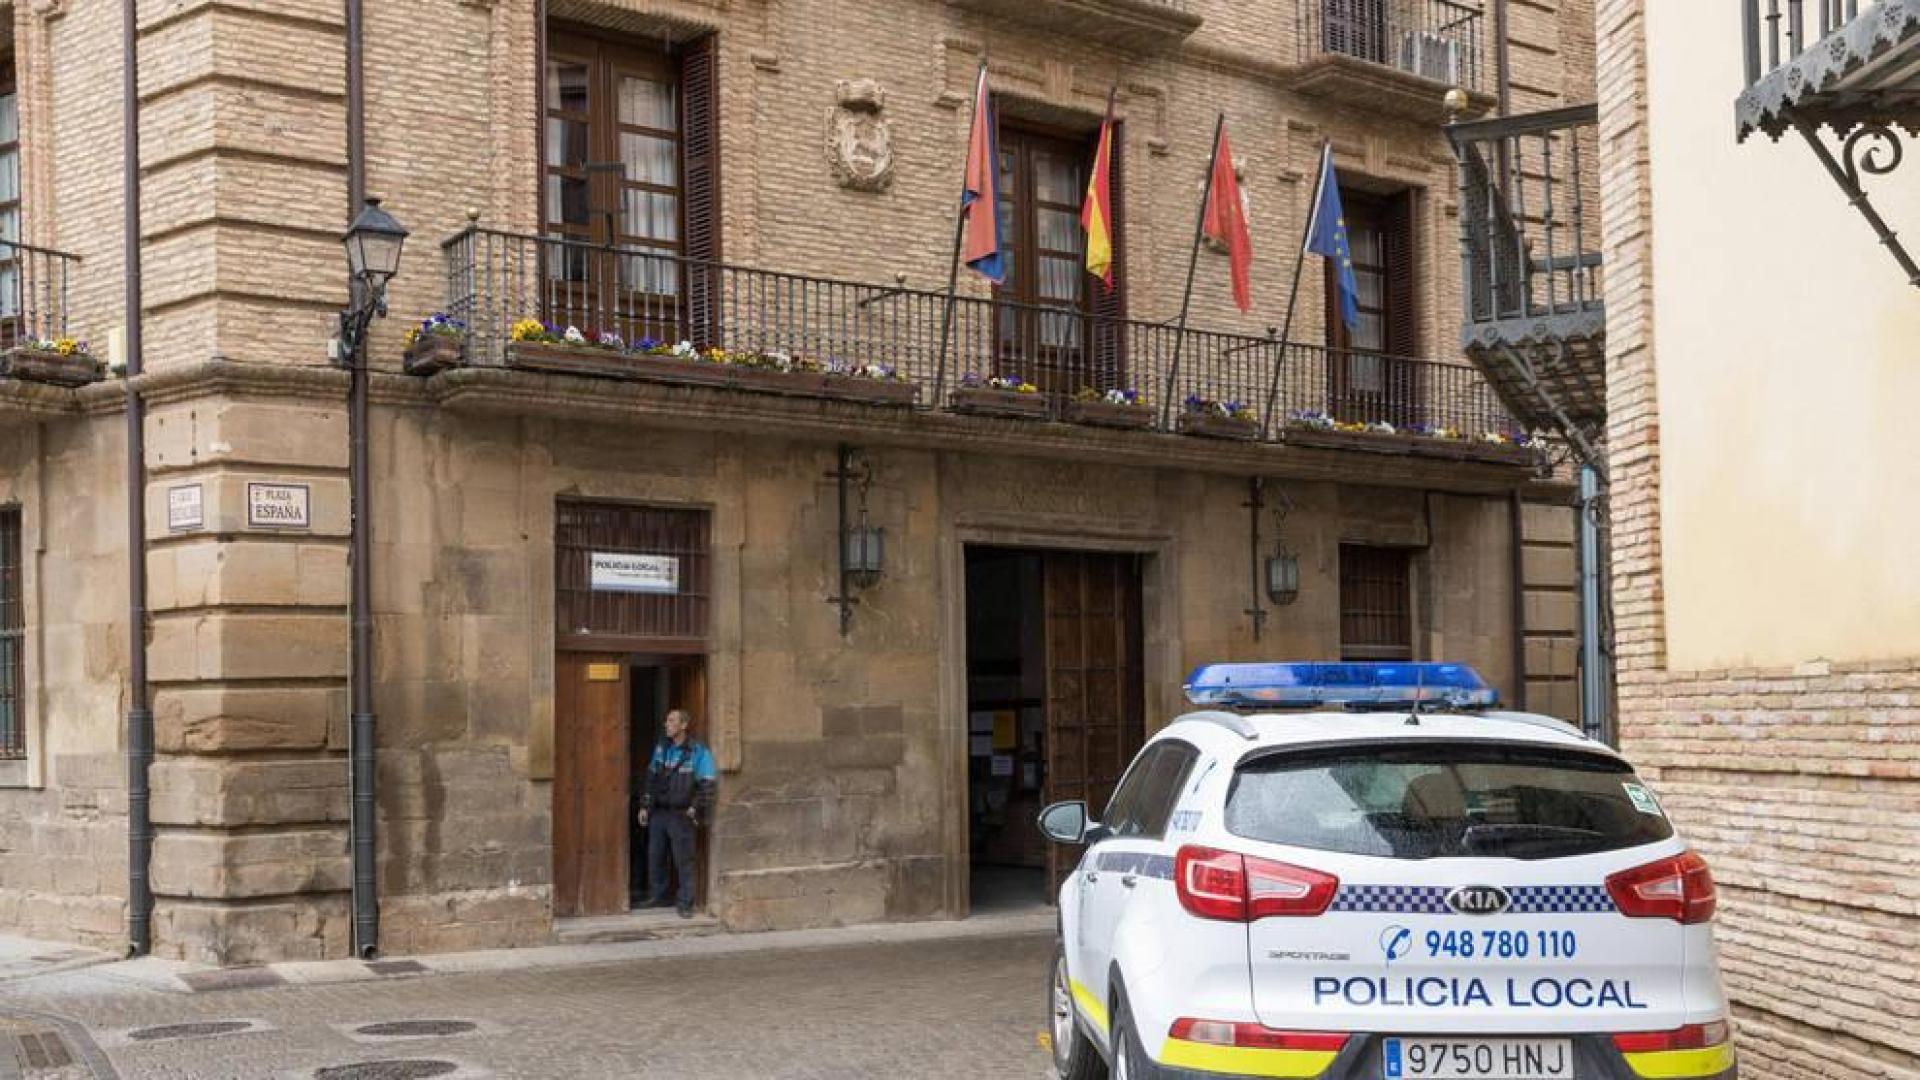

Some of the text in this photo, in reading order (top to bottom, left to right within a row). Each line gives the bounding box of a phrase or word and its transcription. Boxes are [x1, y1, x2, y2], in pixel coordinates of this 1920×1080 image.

[256, 502, 302, 519] ESPAÑA
[1458, 891, 1500, 908] KIA
[1426, 930, 1576, 958] 948 780 110
[1313, 976, 1648, 1008] POLICIA LOCAL
[1408, 1044, 1565, 1074] 9750 HNJ
